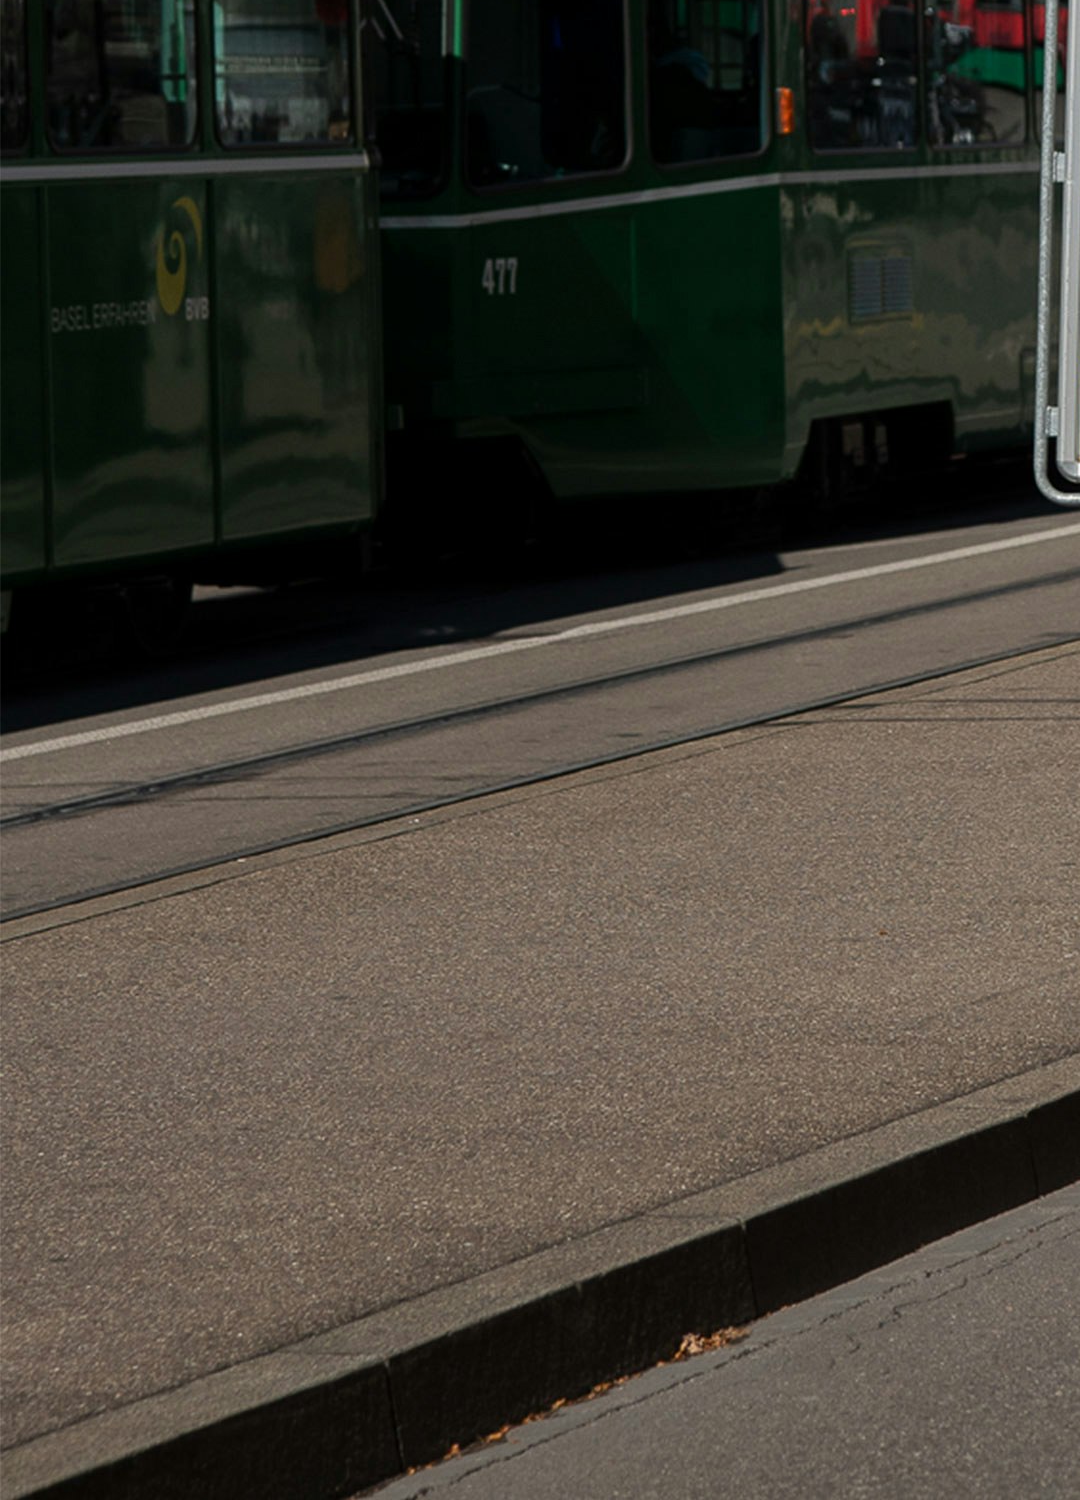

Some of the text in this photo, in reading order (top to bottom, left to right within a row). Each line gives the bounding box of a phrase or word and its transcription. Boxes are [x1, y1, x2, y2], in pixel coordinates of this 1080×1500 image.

[482, 257, 518, 295] 477
[51, 297, 209, 333] BASEL ERFAHREN BVB
